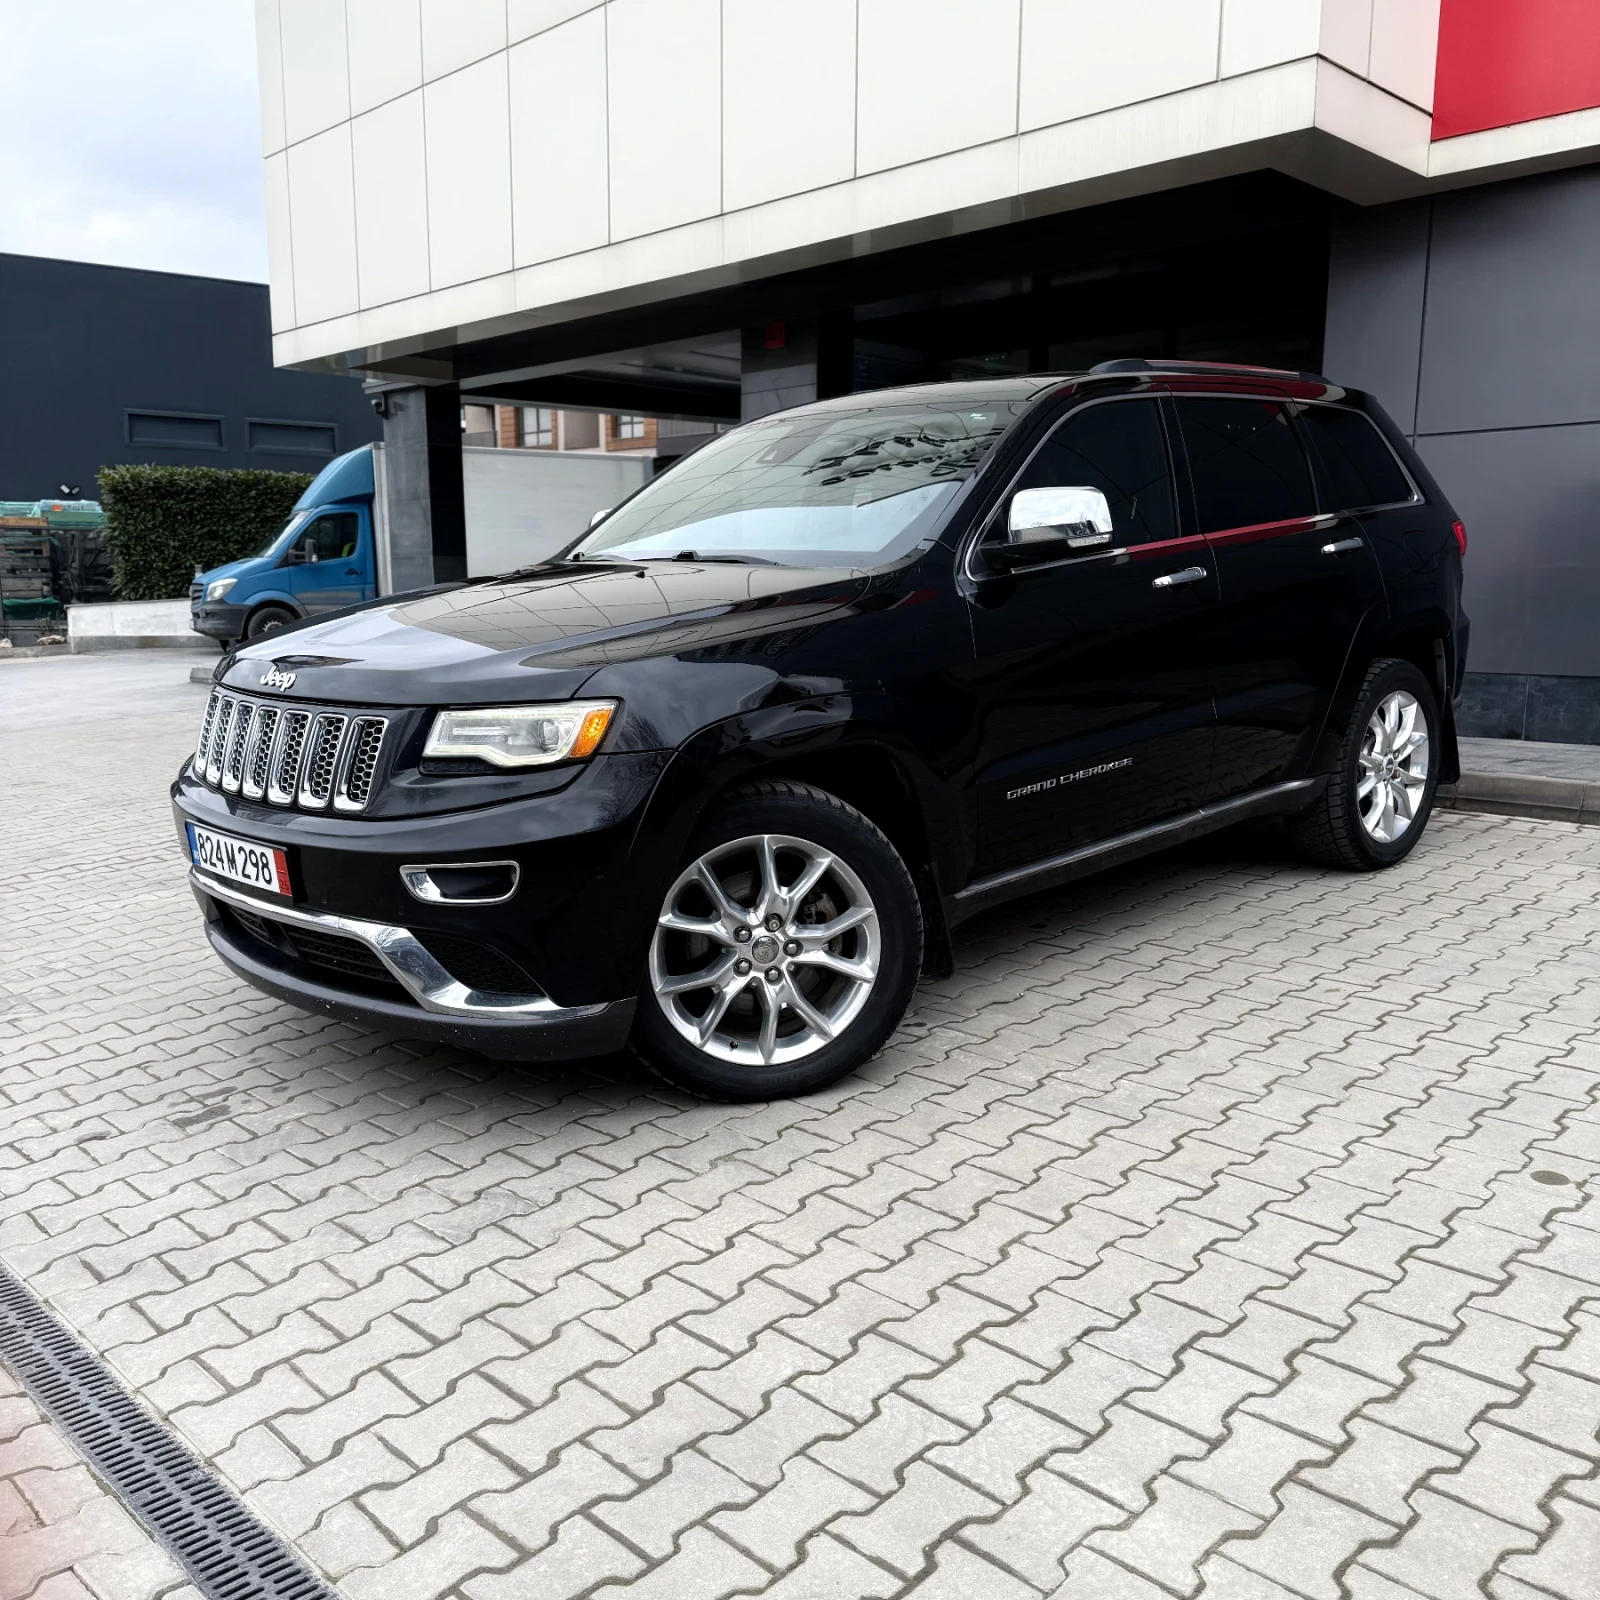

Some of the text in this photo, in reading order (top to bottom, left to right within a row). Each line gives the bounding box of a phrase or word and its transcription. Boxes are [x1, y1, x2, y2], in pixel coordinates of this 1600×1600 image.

[260, 665, 297, 692] Jeep
[1006, 757, 1133, 800] GRAND CHEROKEE
